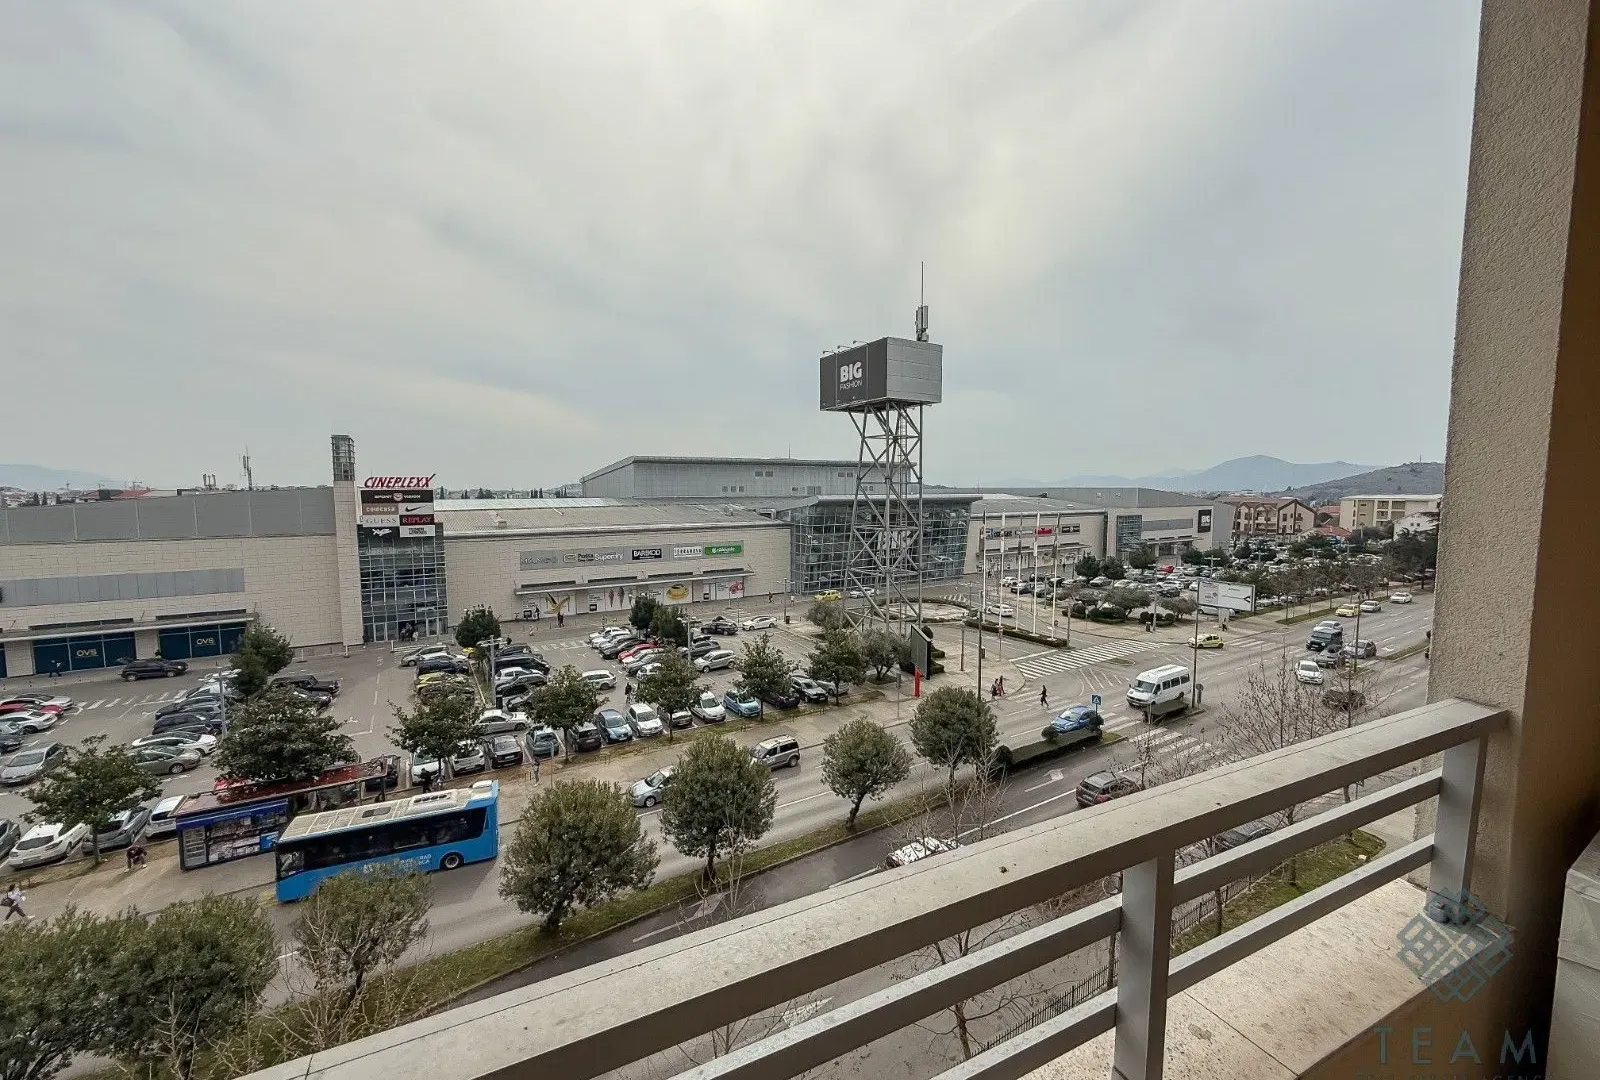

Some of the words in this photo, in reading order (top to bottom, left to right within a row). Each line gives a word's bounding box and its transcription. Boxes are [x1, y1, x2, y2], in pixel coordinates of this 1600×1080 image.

[840, 361, 862, 382] BIG
[840, 379, 862, 391] FASHION
[364, 474, 436, 489] CINEPLEXX
[403, 516, 431, 524] REPLAY
[196, 637, 215, 645] OVS
[76, 648, 97, 657] OVS
